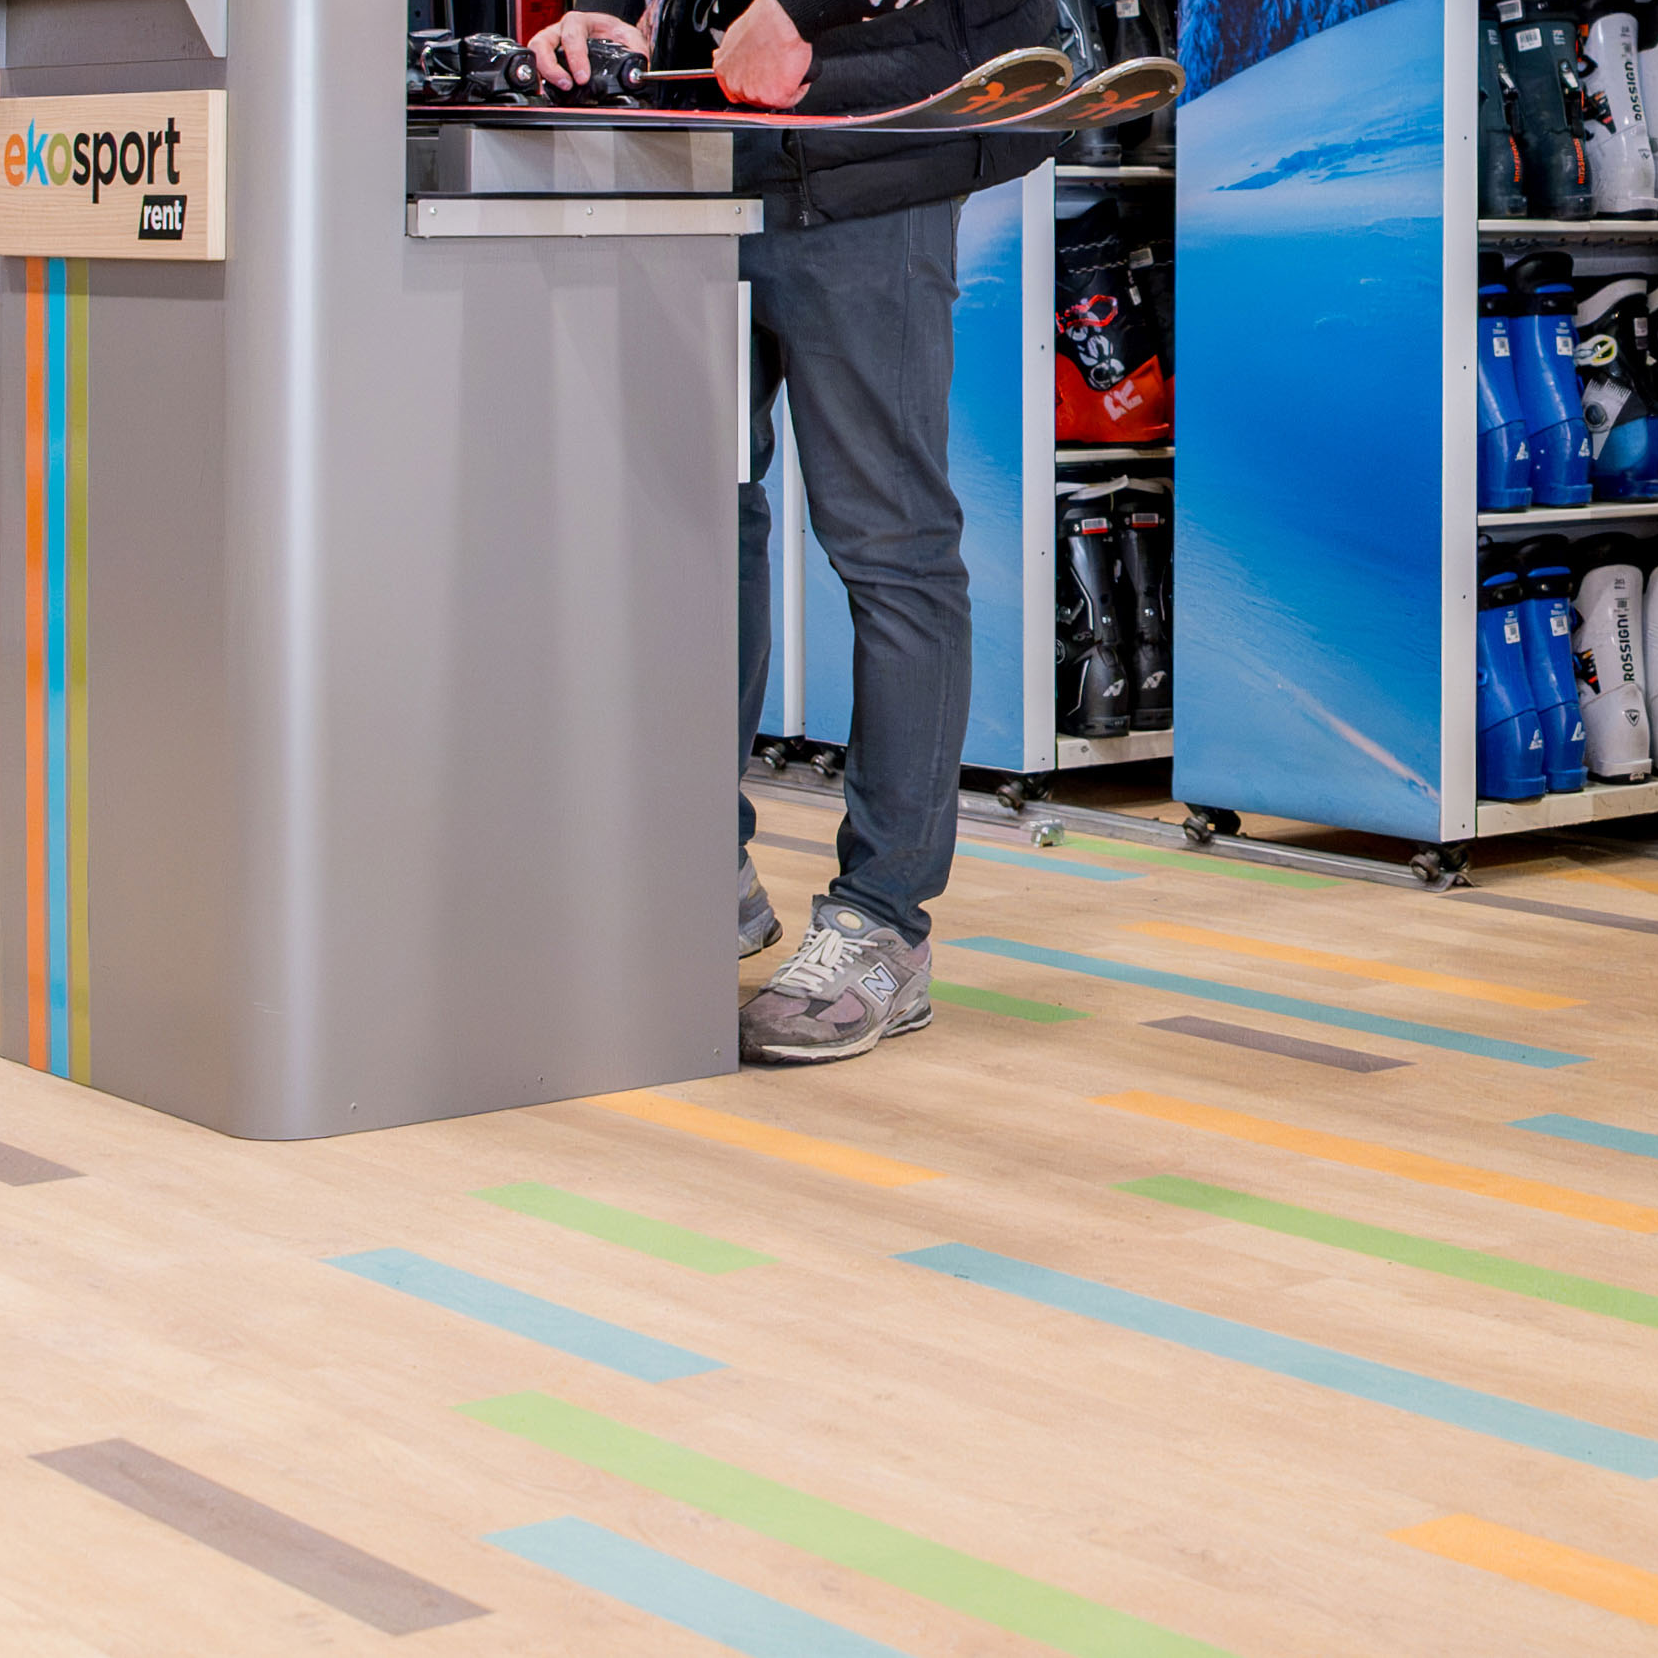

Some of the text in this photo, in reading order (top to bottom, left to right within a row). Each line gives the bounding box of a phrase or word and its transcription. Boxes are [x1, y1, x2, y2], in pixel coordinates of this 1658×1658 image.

[3, 117, 181, 205] ekosport
[143, 199, 184, 231] rent
[1616, 614, 1635, 682] ROSSIGN
